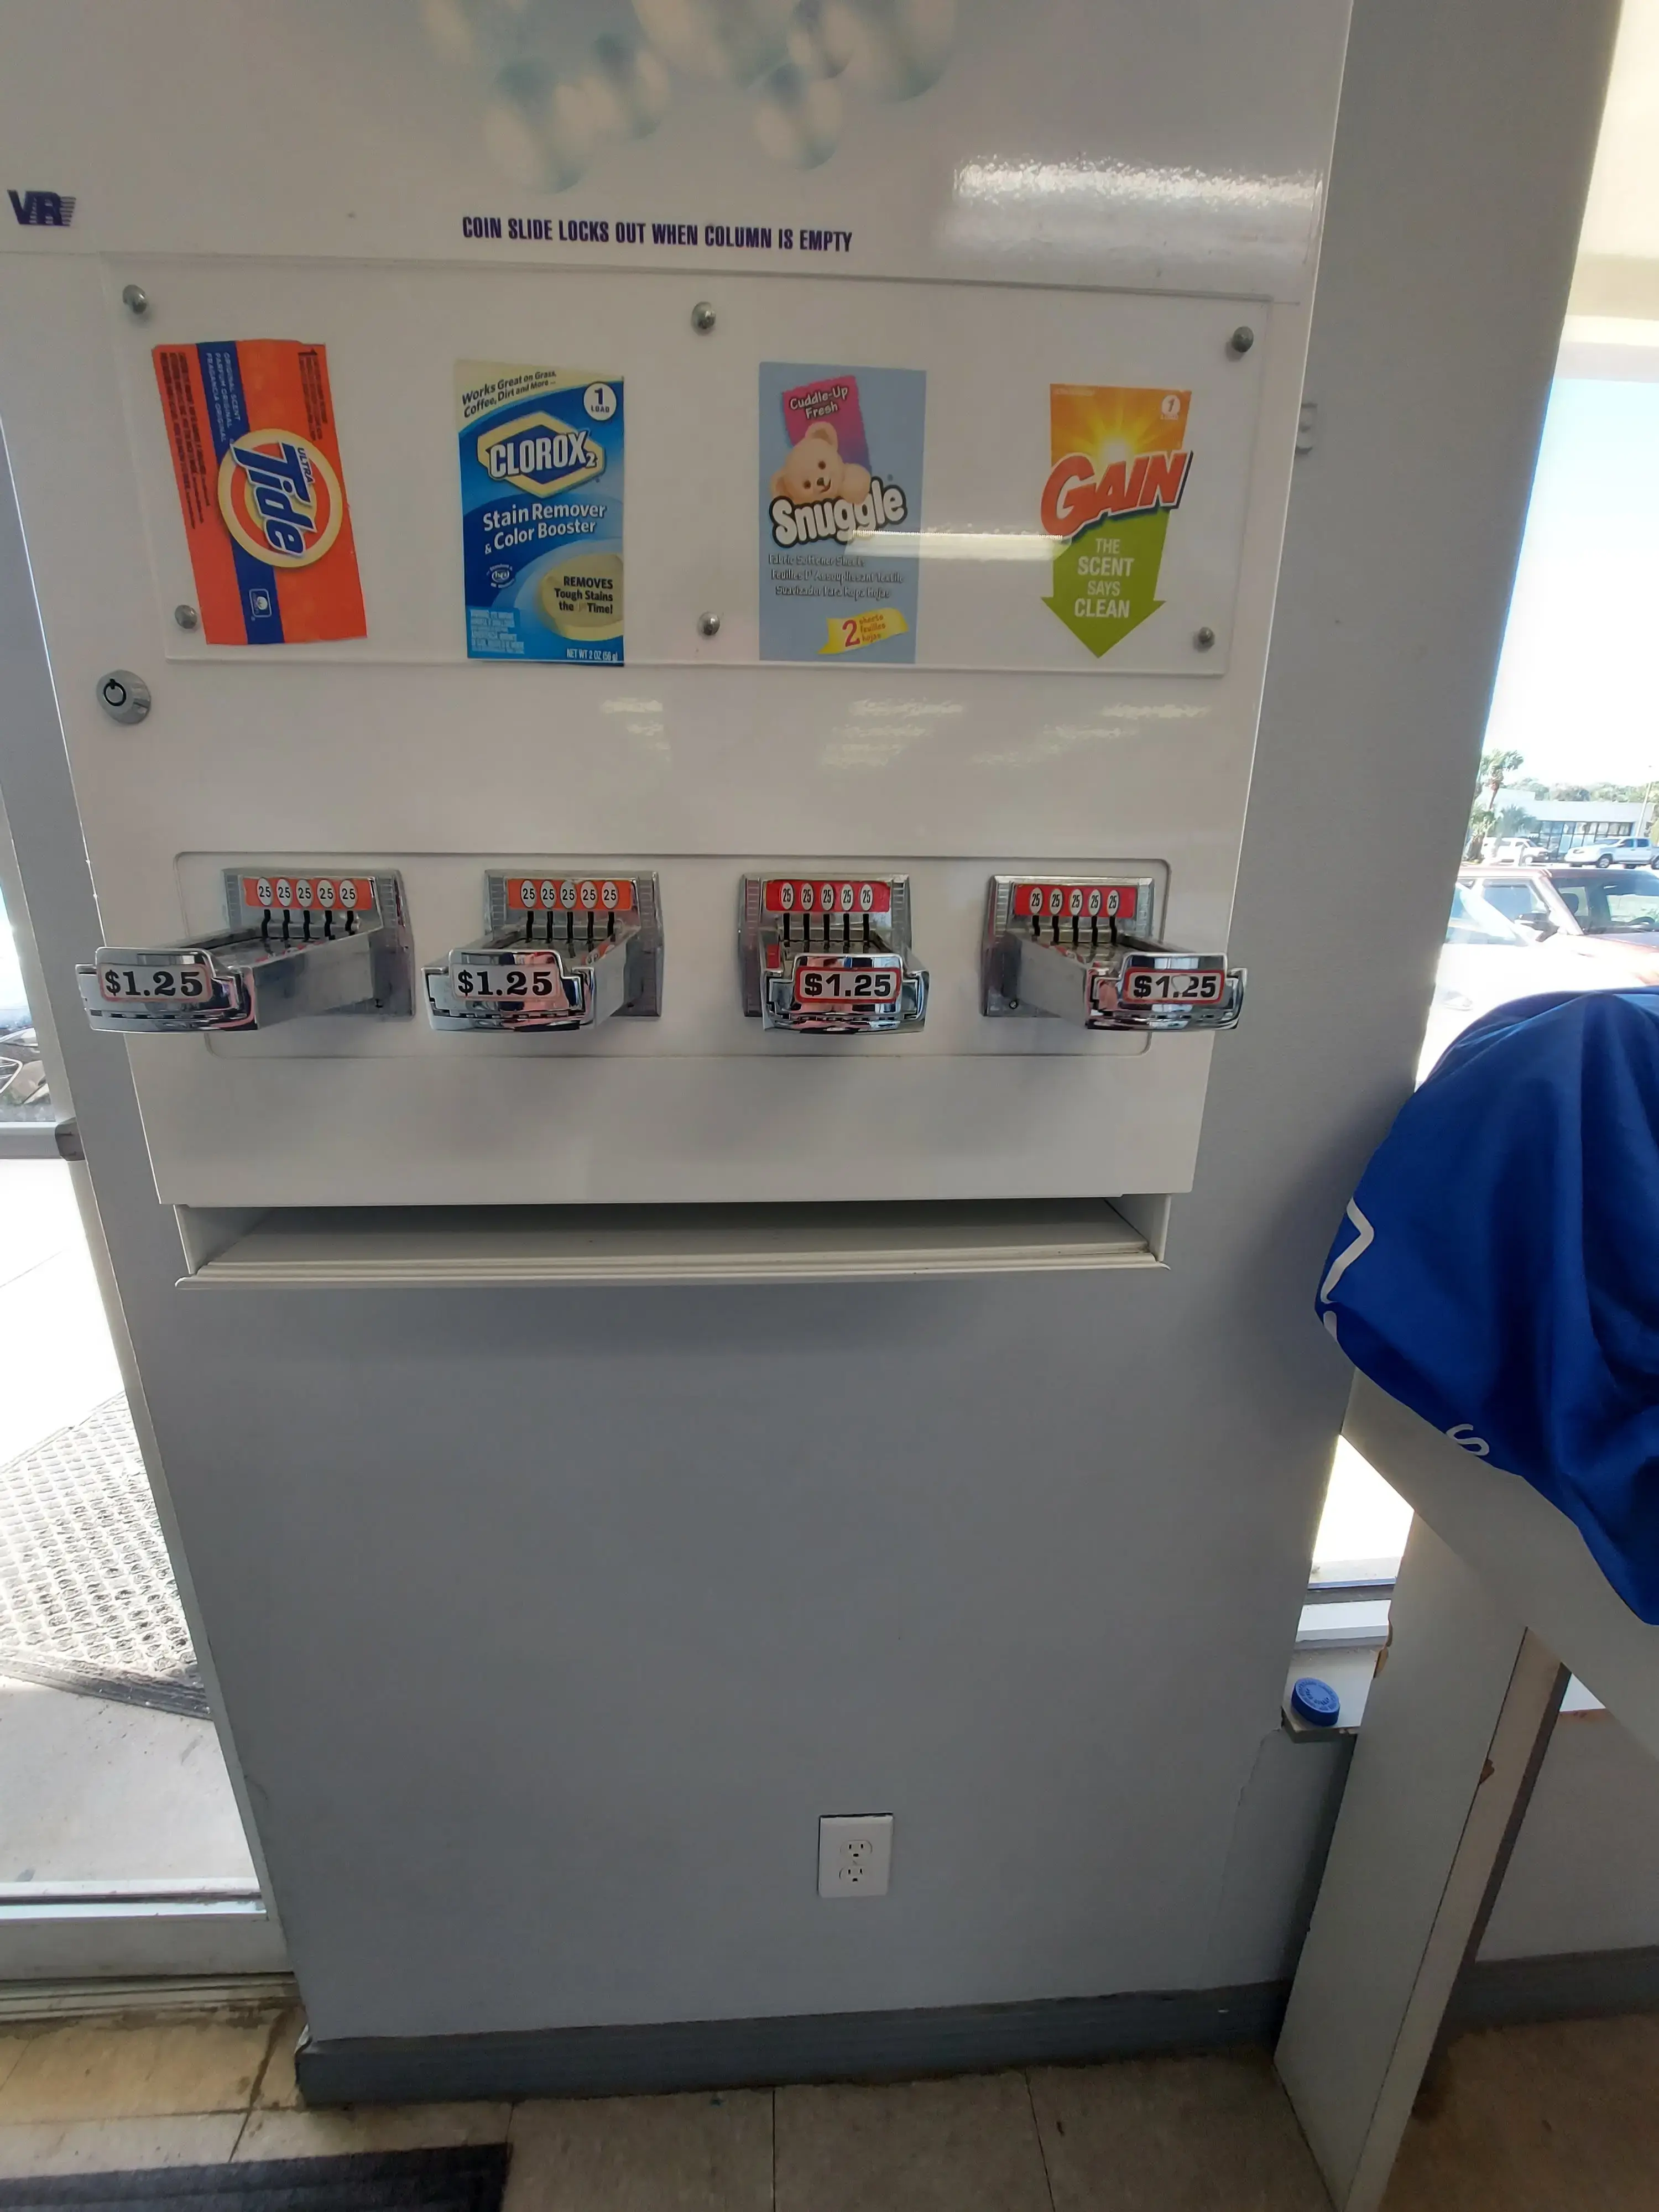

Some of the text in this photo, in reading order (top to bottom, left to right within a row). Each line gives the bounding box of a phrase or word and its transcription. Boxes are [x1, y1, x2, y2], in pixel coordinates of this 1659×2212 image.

[462, 217, 853, 252] COIN SLIDE LOCKS OUT WHEN COLUMN IS EMPTY
[462, 383, 496, 406] Works
[497, 375, 522, 390] Great
[464, 380, 549, 418] Coffee, Dirt and More
[594, 387, 603, 405] 1
[790, 386, 848, 410] Cuddle-Up
[231, 394, 241, 421] SCENT
[591, 404, 610, 413] LOAD
[805, 401, 838, 419] Fresh
[1167, 398, 1175, 413] 1
[297, 447, 314, 483] ULTRA
[231, 441, 317, 556] Tide
[1041, 450, 1190, 540] GAIN
[483, 503, 607, 531] Stain Remover
[771, 478, 906, 546] Snuggle
[485, 519, 596, 555] & Color Booster
[1095, 538, 1120, 554] THE
[1077, 556, 1135, 577] SCENT
[564, 576, 613, 589] REMOVES
[1087, 580, 1120, 596] SAYS
[554, 588, 613, 601] Tough Stains
[559, 601, 574, 611] the
[1074, 598, 1130, 618] CLEAN
[842, 619, 860, 648] 2
[567, 648, 577, 658] NET
[578, 649, 588, 659] WT
[588, 650, 593, 660] 2
[594, 650, 602, 660] OZ
[259, 886, 356, 900] 25 25 25 25 25
[523, 888, 617, 901] 25 25 25 25 25
[783, 888, 871, 904] 25 25 25 25 25
[1031, 893, 1117, 909] 25 25 25 25 25
[105, 969, 202, 997] $1.25
[458, 969, 552, 997] $1.25
[805, 973, 891, 997] $1.25
[1134, 975, 1216, 998] $1.25
